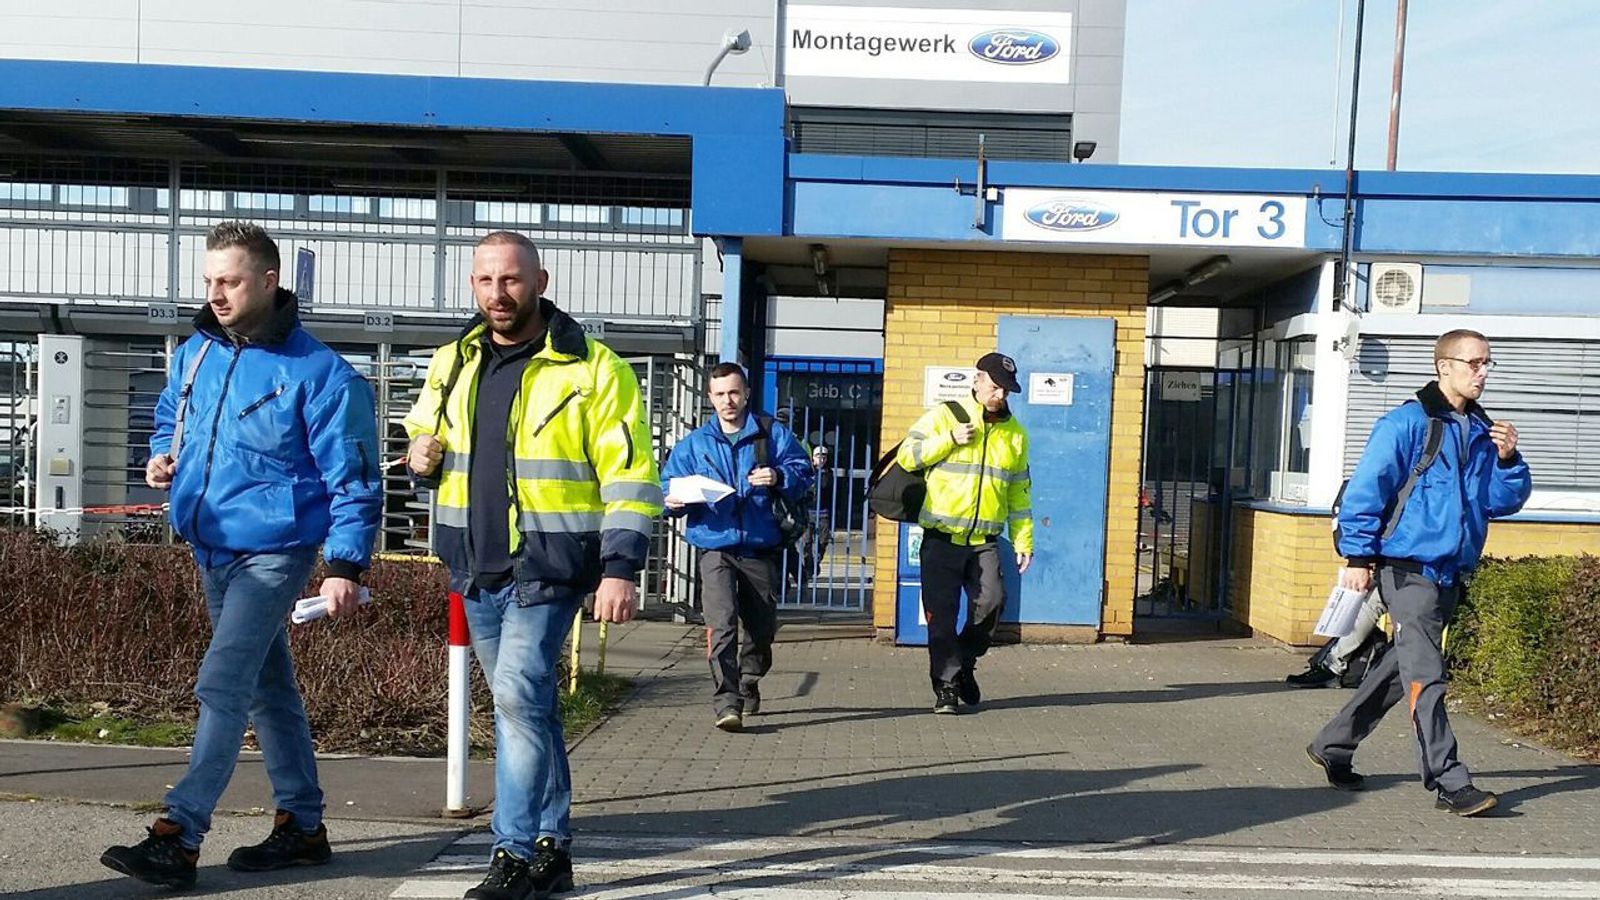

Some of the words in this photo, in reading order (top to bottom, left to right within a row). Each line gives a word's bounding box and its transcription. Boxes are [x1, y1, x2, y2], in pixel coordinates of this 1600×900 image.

[792, 29, 956, 57] Montagewerk
[1170, 200, 1239, 238] Tor
[1257, 200, 1285, 239] 3
[151, 308, 175, 319] D3.3
[366, 316, 390, 327] D3.2
